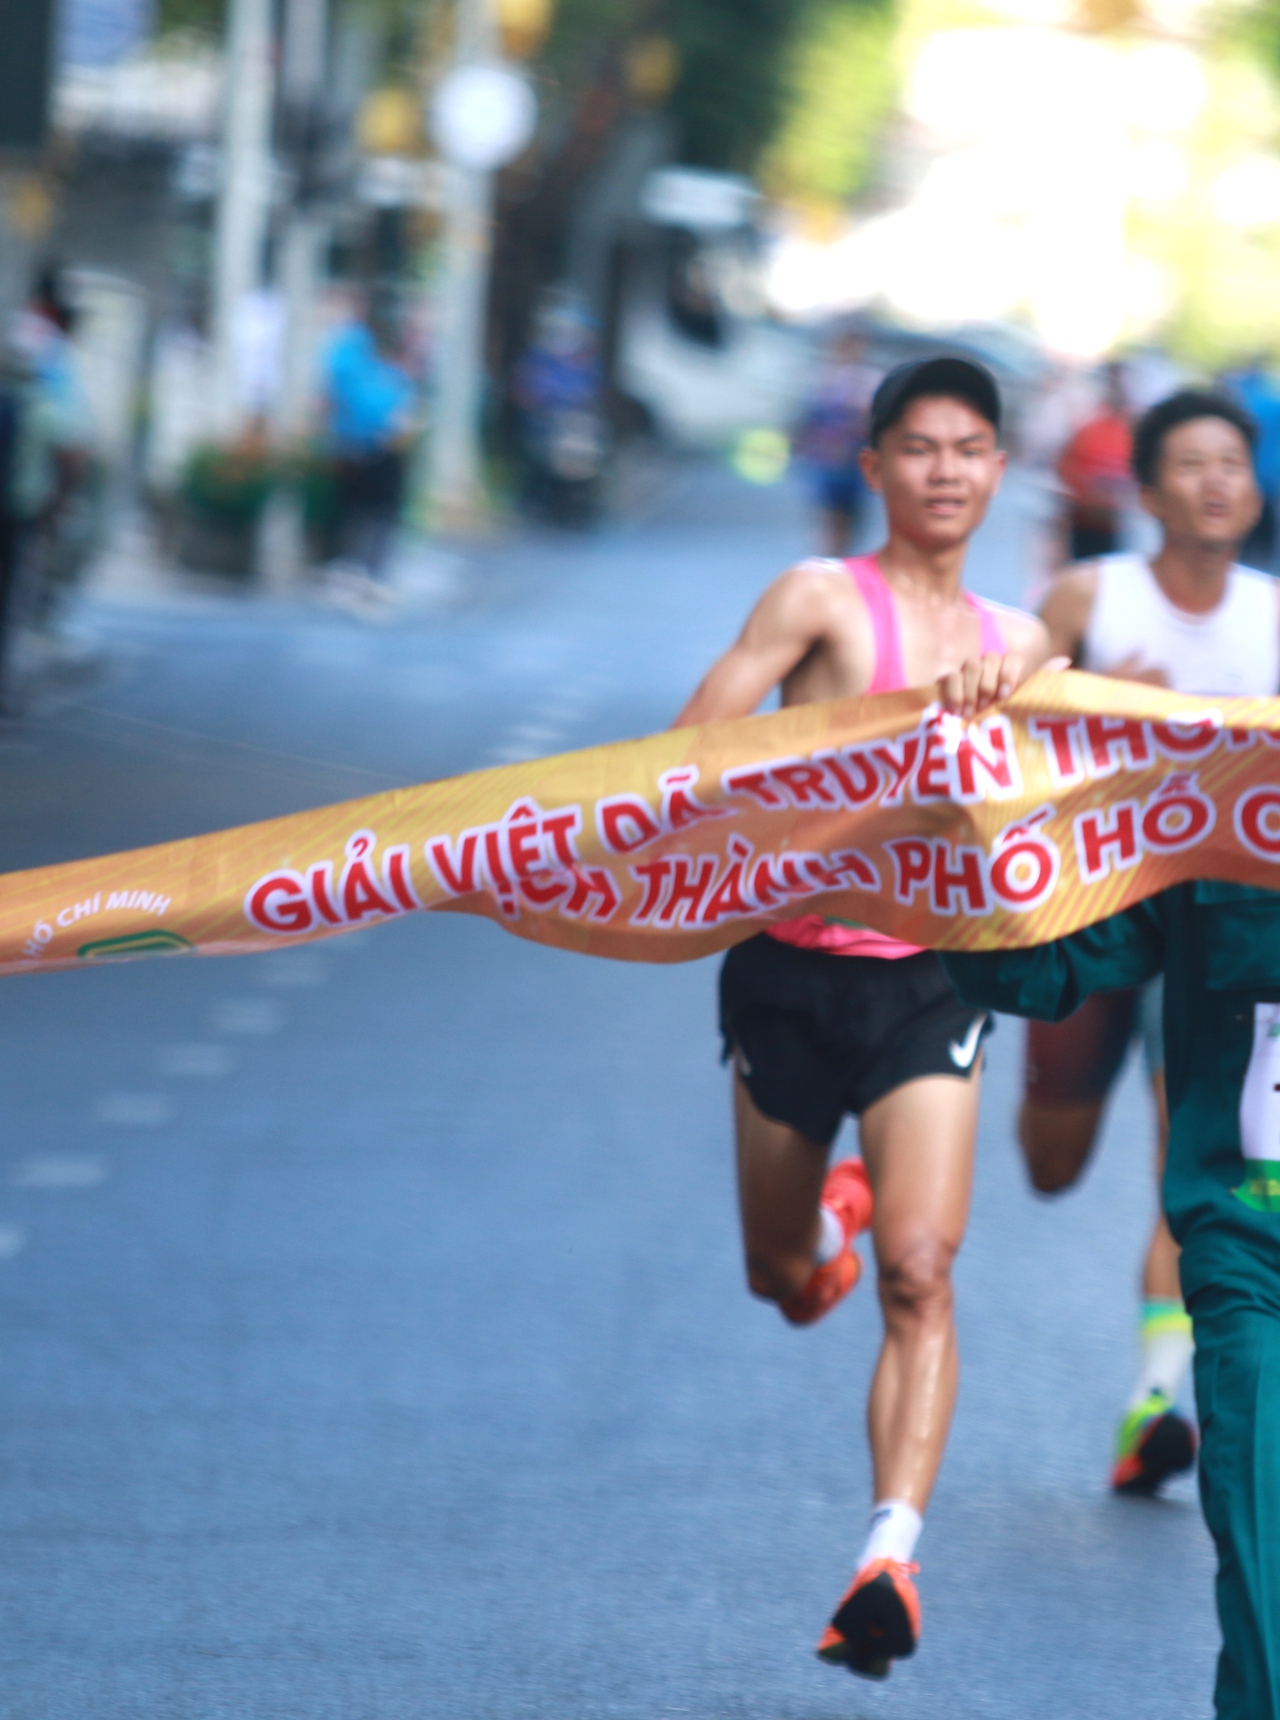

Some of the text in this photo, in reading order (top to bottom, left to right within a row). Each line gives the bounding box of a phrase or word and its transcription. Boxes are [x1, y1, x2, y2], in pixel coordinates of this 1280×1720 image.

[56, 891, 101, 928] CHÍ
[105, 889, 173, 917] MINH
[247, 833, 421, 935] GIẢI
[598, 770, 724, 855] DÃ
[889, 809, 1055, 911] PHỐ
[1078, 773, 1212, 877] HỒ
